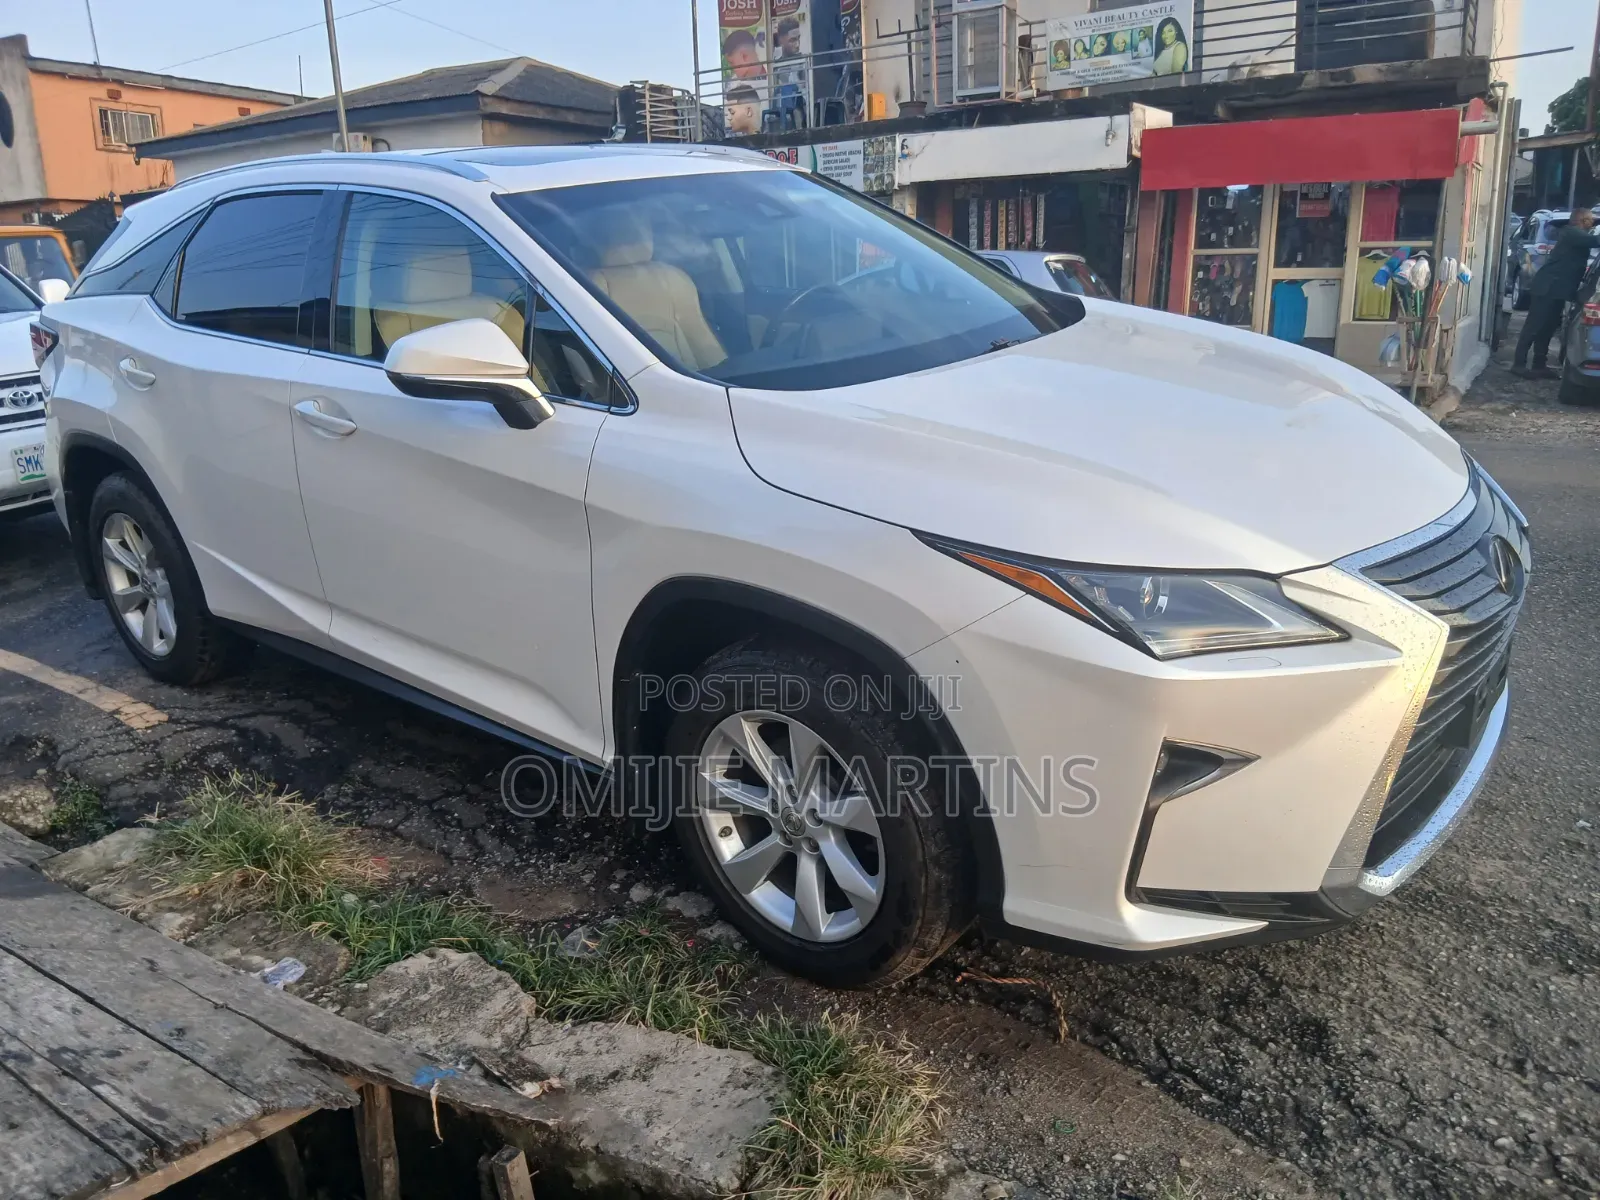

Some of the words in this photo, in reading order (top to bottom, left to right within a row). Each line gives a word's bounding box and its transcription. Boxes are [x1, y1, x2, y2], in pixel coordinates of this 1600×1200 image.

[722, 0, 757, 12] JOSH
[1074, 17, 1102, 28] VIVANI
[1104, 11, 1139, 23] BEAUTY
[1142, 5, 1176, 17] CASTLE
[16, 453, 44, 474] SMK
